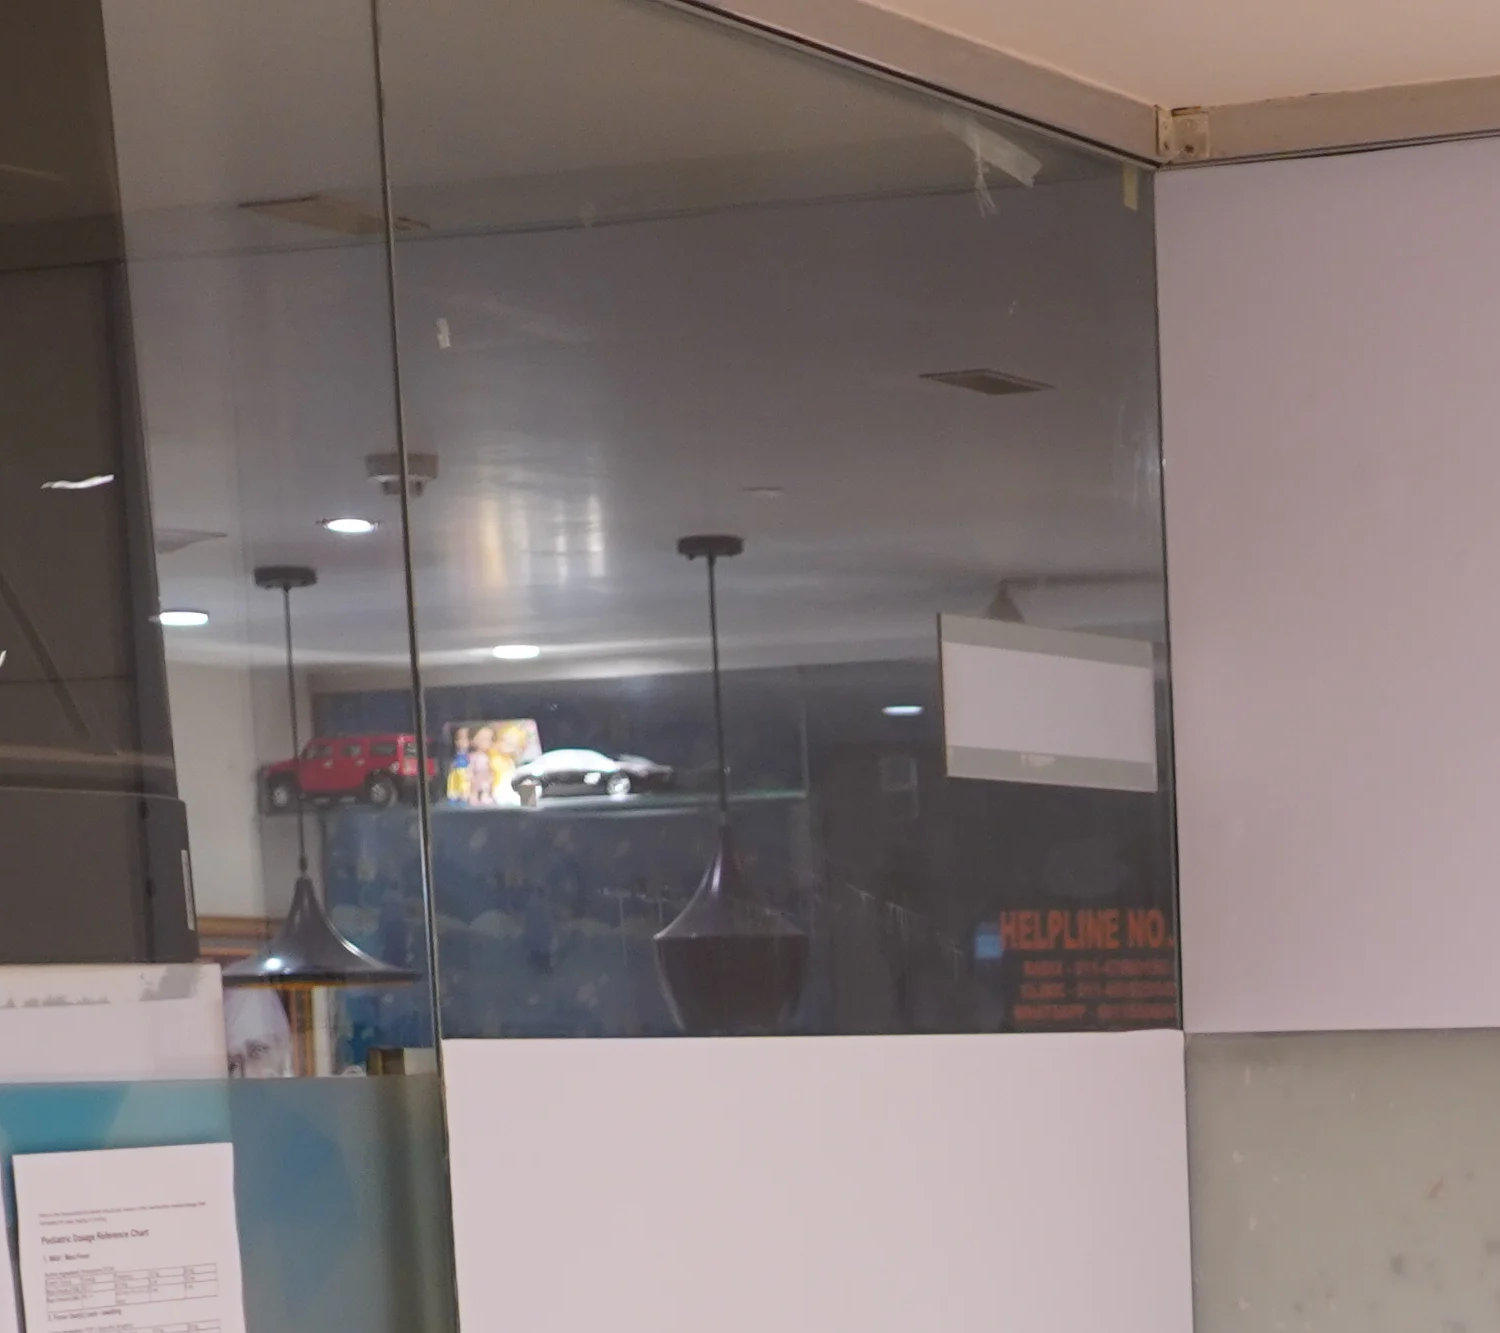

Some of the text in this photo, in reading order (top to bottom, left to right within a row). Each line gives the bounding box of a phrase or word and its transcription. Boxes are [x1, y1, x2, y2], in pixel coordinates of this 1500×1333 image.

[1000, 909, 1119, 950] HELPLINE
[41, 1229, 149, 1244] Pediatric Dosage Reference Chart
